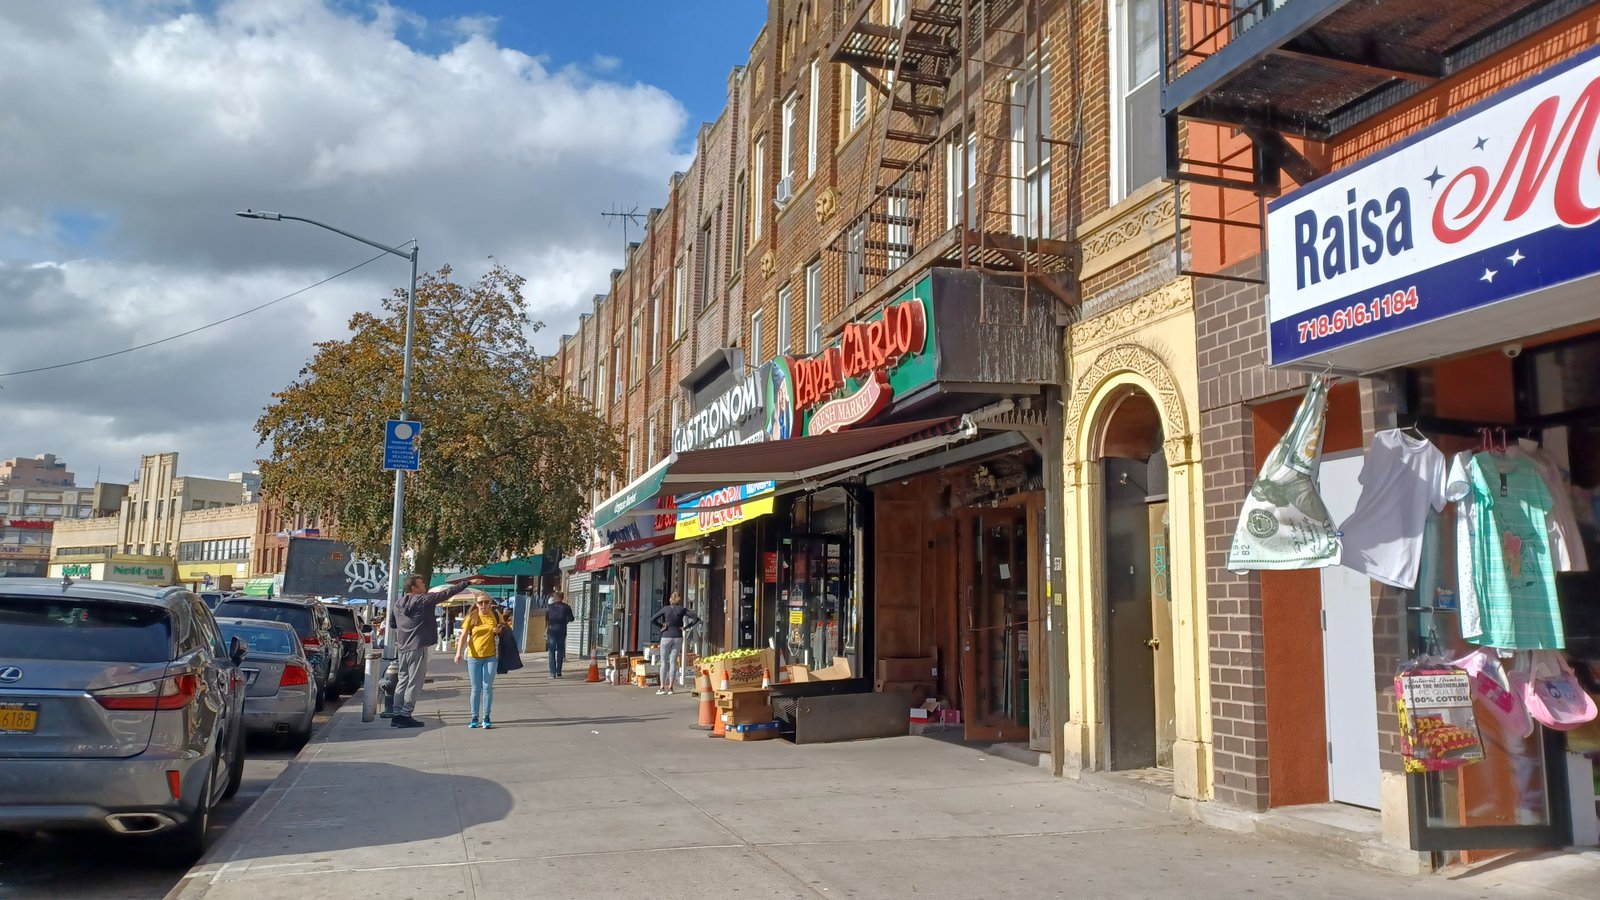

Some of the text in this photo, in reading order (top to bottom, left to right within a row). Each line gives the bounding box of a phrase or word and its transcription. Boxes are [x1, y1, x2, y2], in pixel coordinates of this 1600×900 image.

[1294, 186, 1414, 291] Raisa
[1298, 285, 1419, 343] 718.616.1184
[794, 301, 913, 410] PAPA CARLO
[674, 372, 757, 453] GASTRONOM
[810, 388, 873, 436] FRESH MARKET
